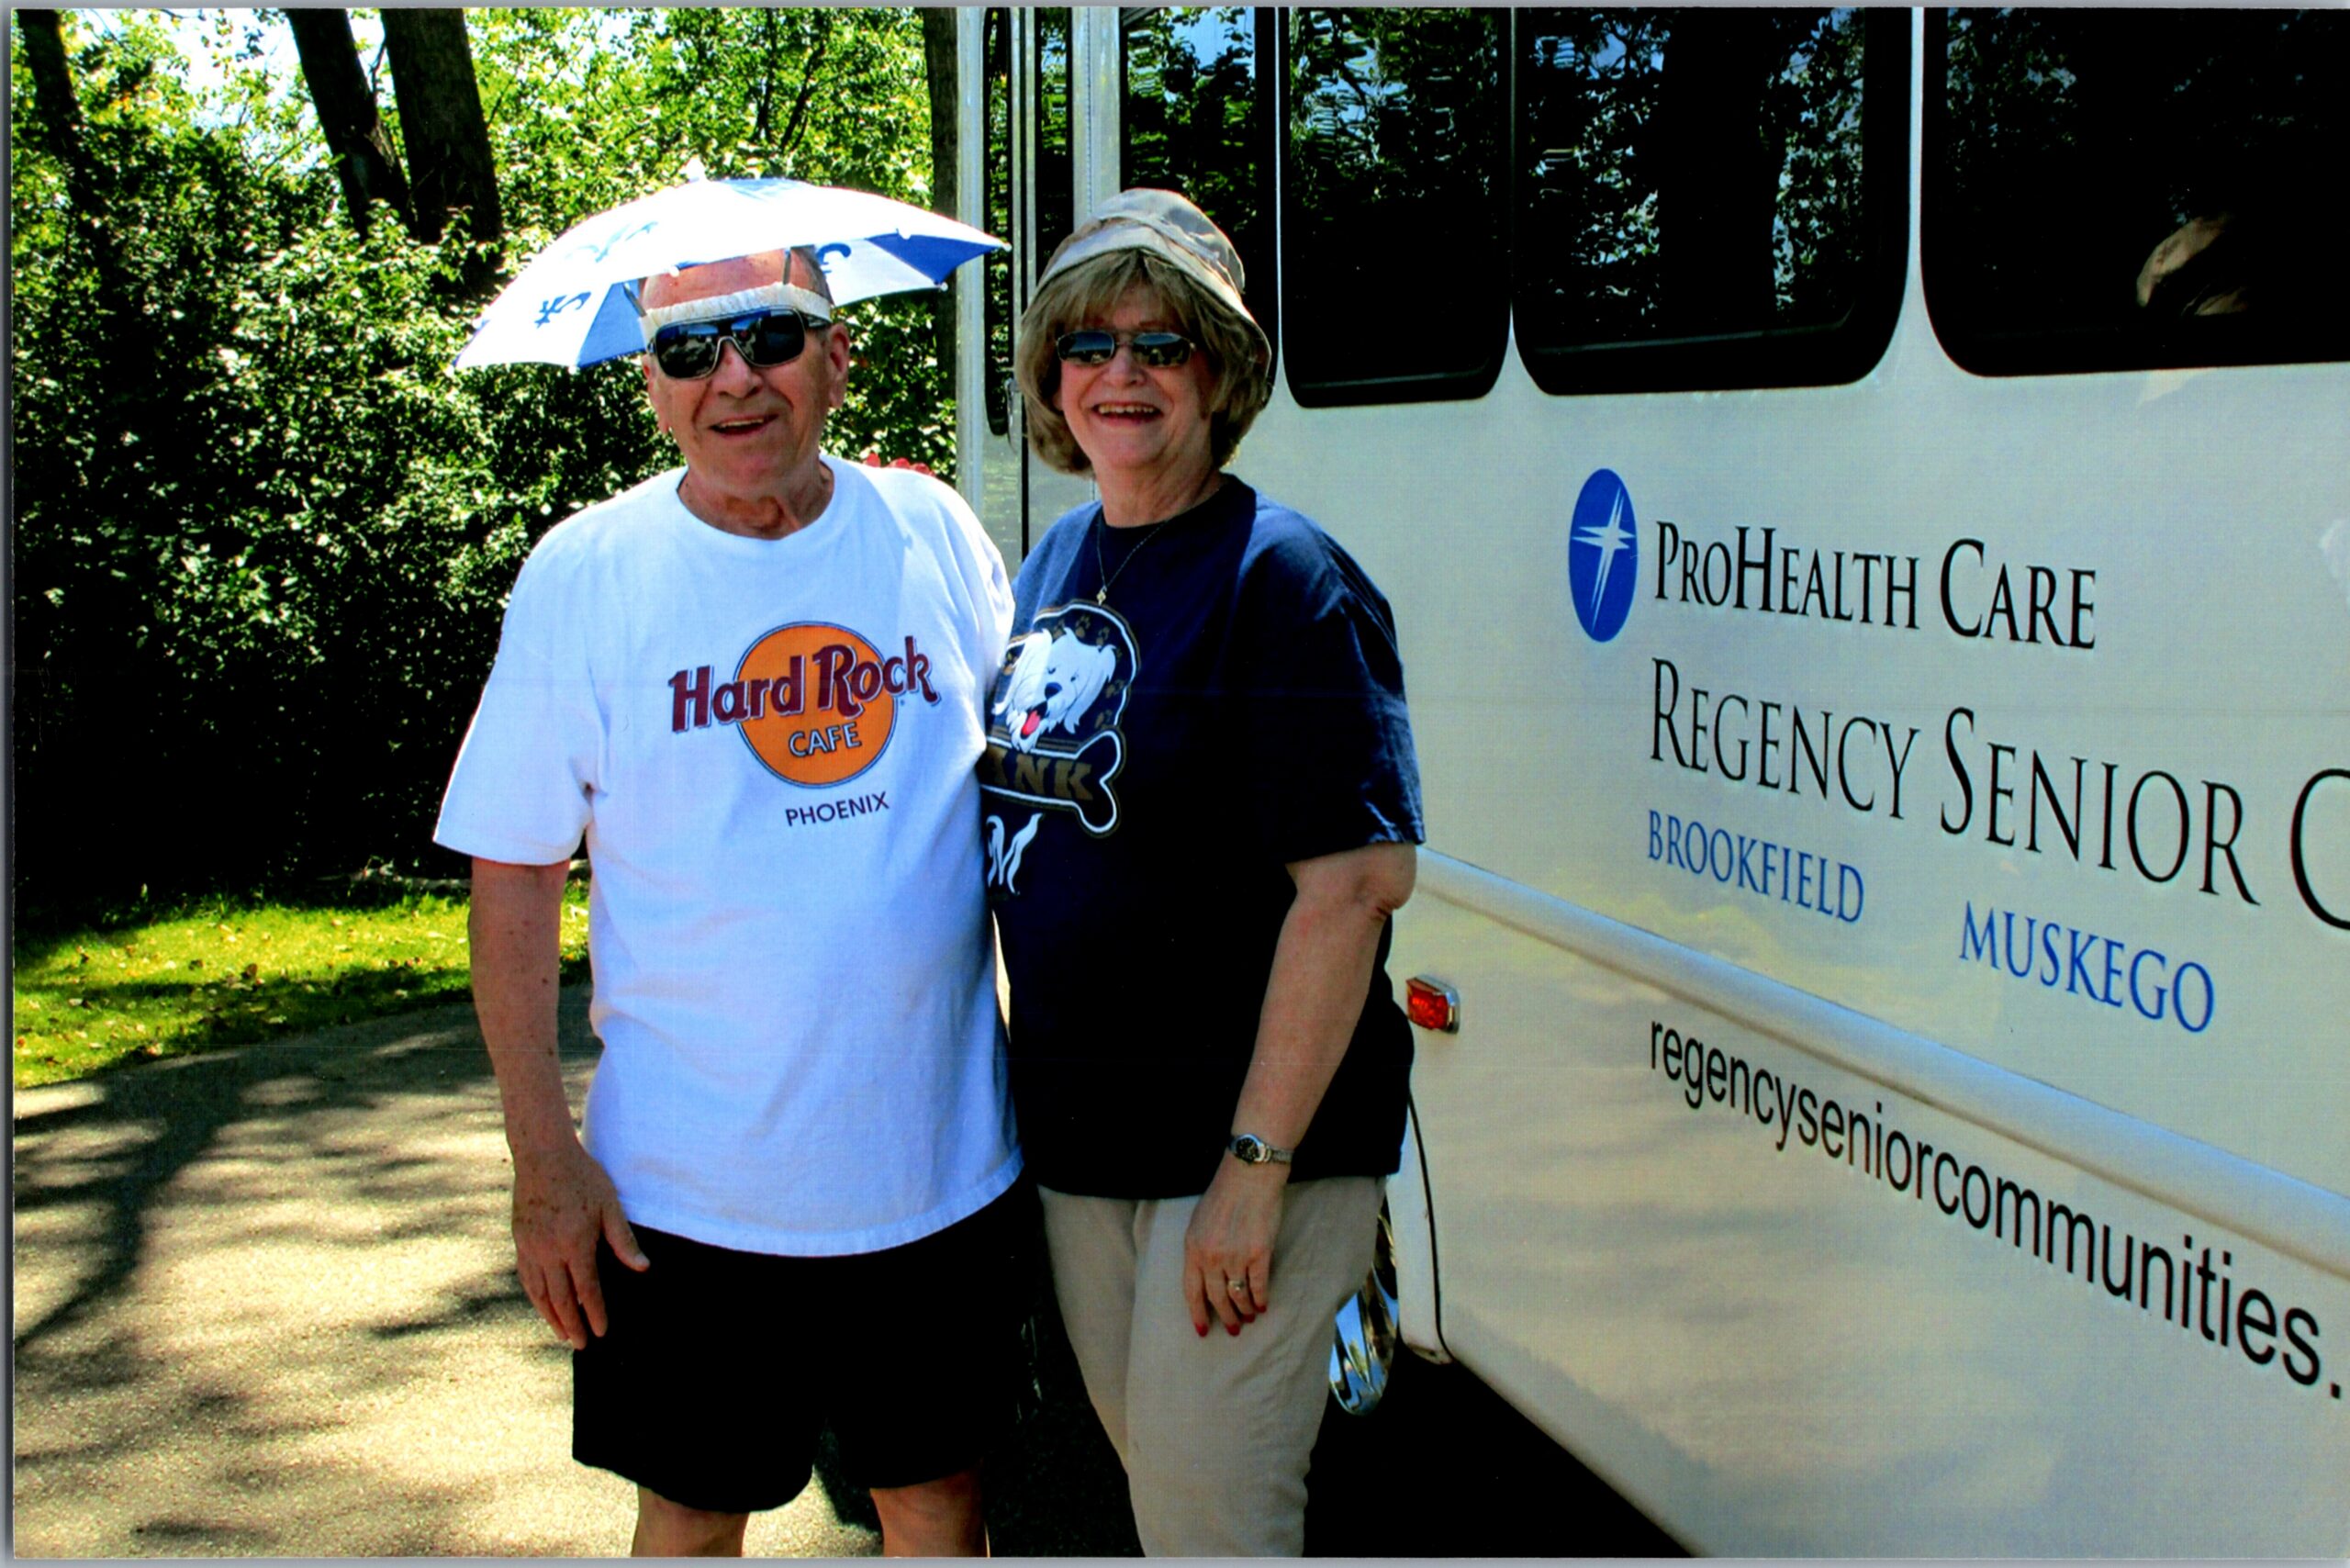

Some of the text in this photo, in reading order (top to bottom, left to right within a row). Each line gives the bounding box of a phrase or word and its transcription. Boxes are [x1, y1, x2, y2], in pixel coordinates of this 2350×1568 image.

[1939, 537, 2097, 650] CARE
[668, 635, 941, 733] Hard Rock
[789, 722, 862, 757] CAFE
[785, 791, 890, 826] PHOENIX
[1651, 657, 1920, 820] REGENCY
[1940, 706, 2261, 906] SENIOR
[1648, 809, 1865, 924] BROOKFIELD
[1959, 900, 2217, 1035] MUSKEGO
[1651, 1019, 2342, 1400] regencyseniorcommunities.
